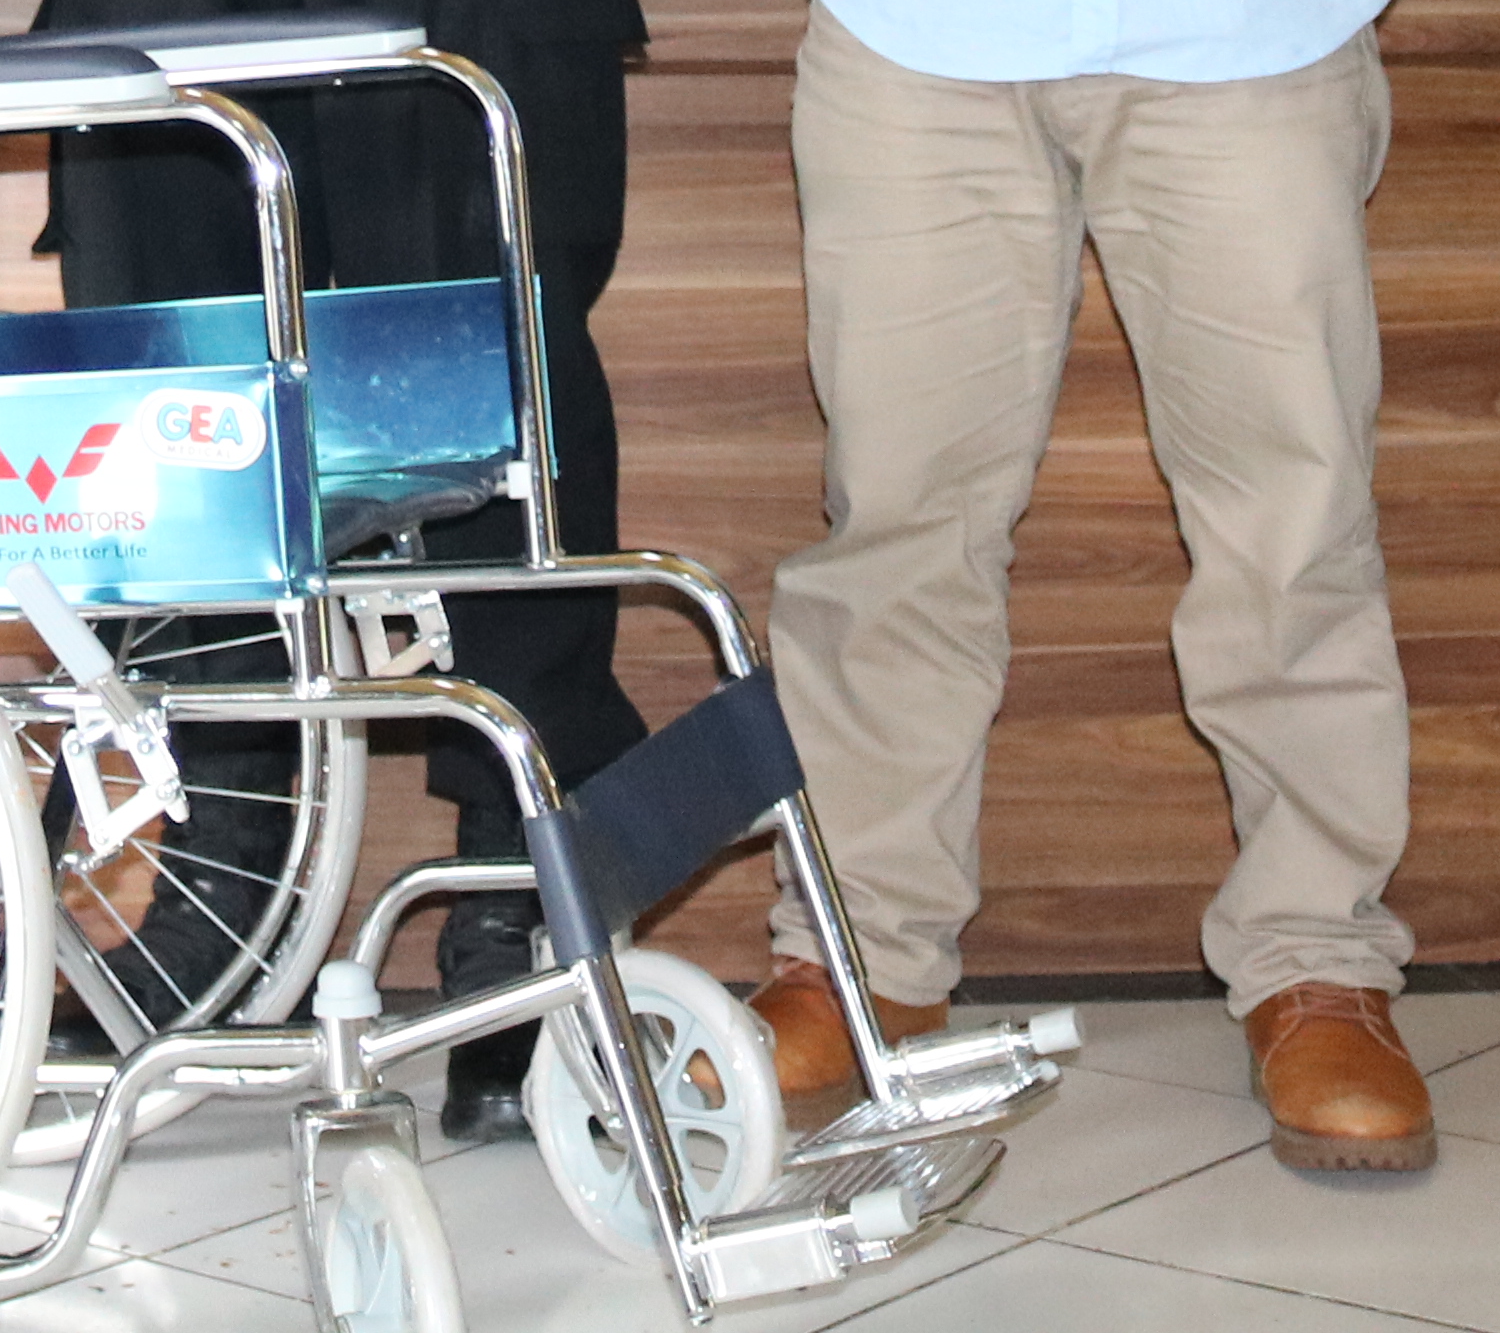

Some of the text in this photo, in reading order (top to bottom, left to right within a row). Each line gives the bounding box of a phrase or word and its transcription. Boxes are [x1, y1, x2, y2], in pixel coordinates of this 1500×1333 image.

[156, 402, 243, 446] GEA
[45, 511, 147, 533] MOTORS
[33, 546, 45, 561] A
[51, 544, 109, 561] Better
[114, 543, 148, 560] Life
